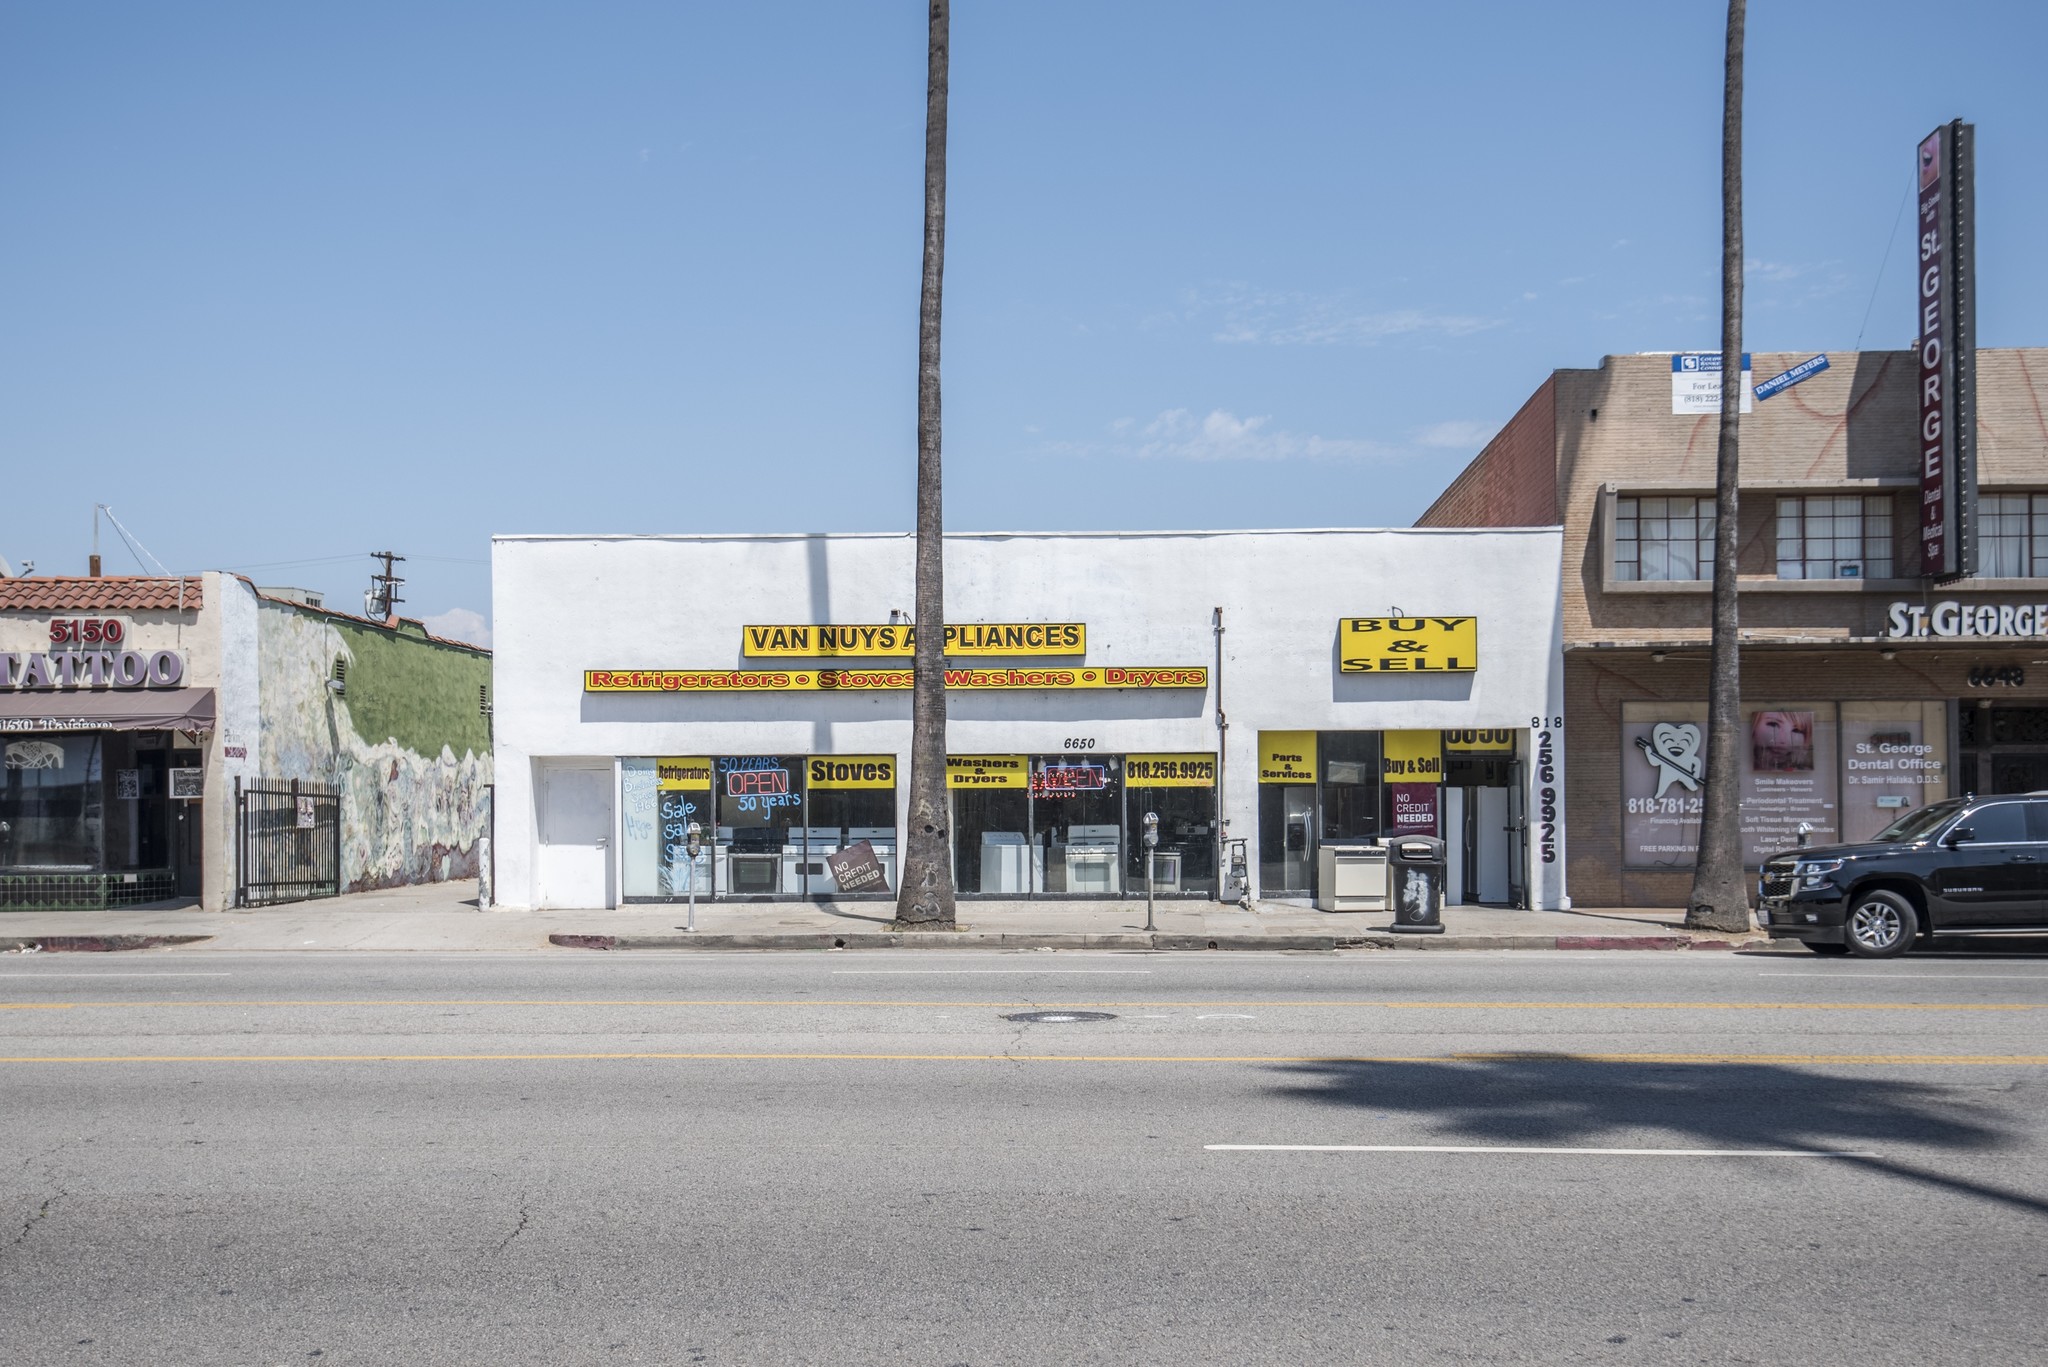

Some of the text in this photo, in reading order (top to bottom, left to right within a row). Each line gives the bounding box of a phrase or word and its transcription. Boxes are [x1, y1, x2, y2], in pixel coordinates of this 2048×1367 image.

[1921, 228, 1942, 261] St.
[1756, 371, 1790, 395] DANIEL
[1789, 355, 1825, 378] MEYERS
[1922, 265, 1941, 478] GEORGE
[1693, 383, 1705, 391] For
[1684, 394, 1703, 405] (818)
[49, 619, 122, 643] 5150
[1351, 619, 1468, 632] BUY
[751, 625, 1080, 650] VAN NUYS APLIANCES
[1387, 639, 1429, 653] &
[0, 650, 184, 687] TATTOO
[1343, 657, 1475, 671] SELL
[590, 671, 789, 690] Refrigerators
[944, 669, 1075, 686] Washers
[1105, 668, 1205, 687] Dryers
[1531, 717, 1563, 729] 818
[1064, 738, 1095, 749] 6650
[1856, 743, 1932, 756] St. George
[719, 757, 779, 772] 50 YEARS
[946, 758, 1019, 768] Washers
[1272, 753, 1302, 762] Parts
[1848, 758, 1941, 770] Dental Office
[659, 765, 710, 780] Refrigerators
[811, 760, 891, 782] Stoves
[974, 767, 986, 775] &
[1127, 761, 1213, 779] 818.256.9925
[1384, 757, 1440, 775] Buy & Sell
[953, 774, 1008, 784] Dryers
[1047, 768, 1103, 787] OPEN
[1262, 770, 1312, 779] Services
[1848, 776, 1860, 784] Dr.
[1861, 776, 1884, 784] Samir
[1916, 775, 1942, 784] D.D.S.
[729, 773, 786, 794] OPEN
[1396, 793, 1410, 803] NO
[660, 795, 696, 819] Sale
[738, 793, 801, 820] 50 years
[1396, 803, 1429, 813] CREDIT
[1396, 813, 1434, 823] NEEDED
[1783, 816, 1826, 825] Management
[663, 816, 687, 840] sal
[1756, 826, 1790, 834] Whitening
[834, 861, 849, 874] NO
[838, 862, 871, 883] CREDIT
[842, 869, 880, 891] NEEDED
